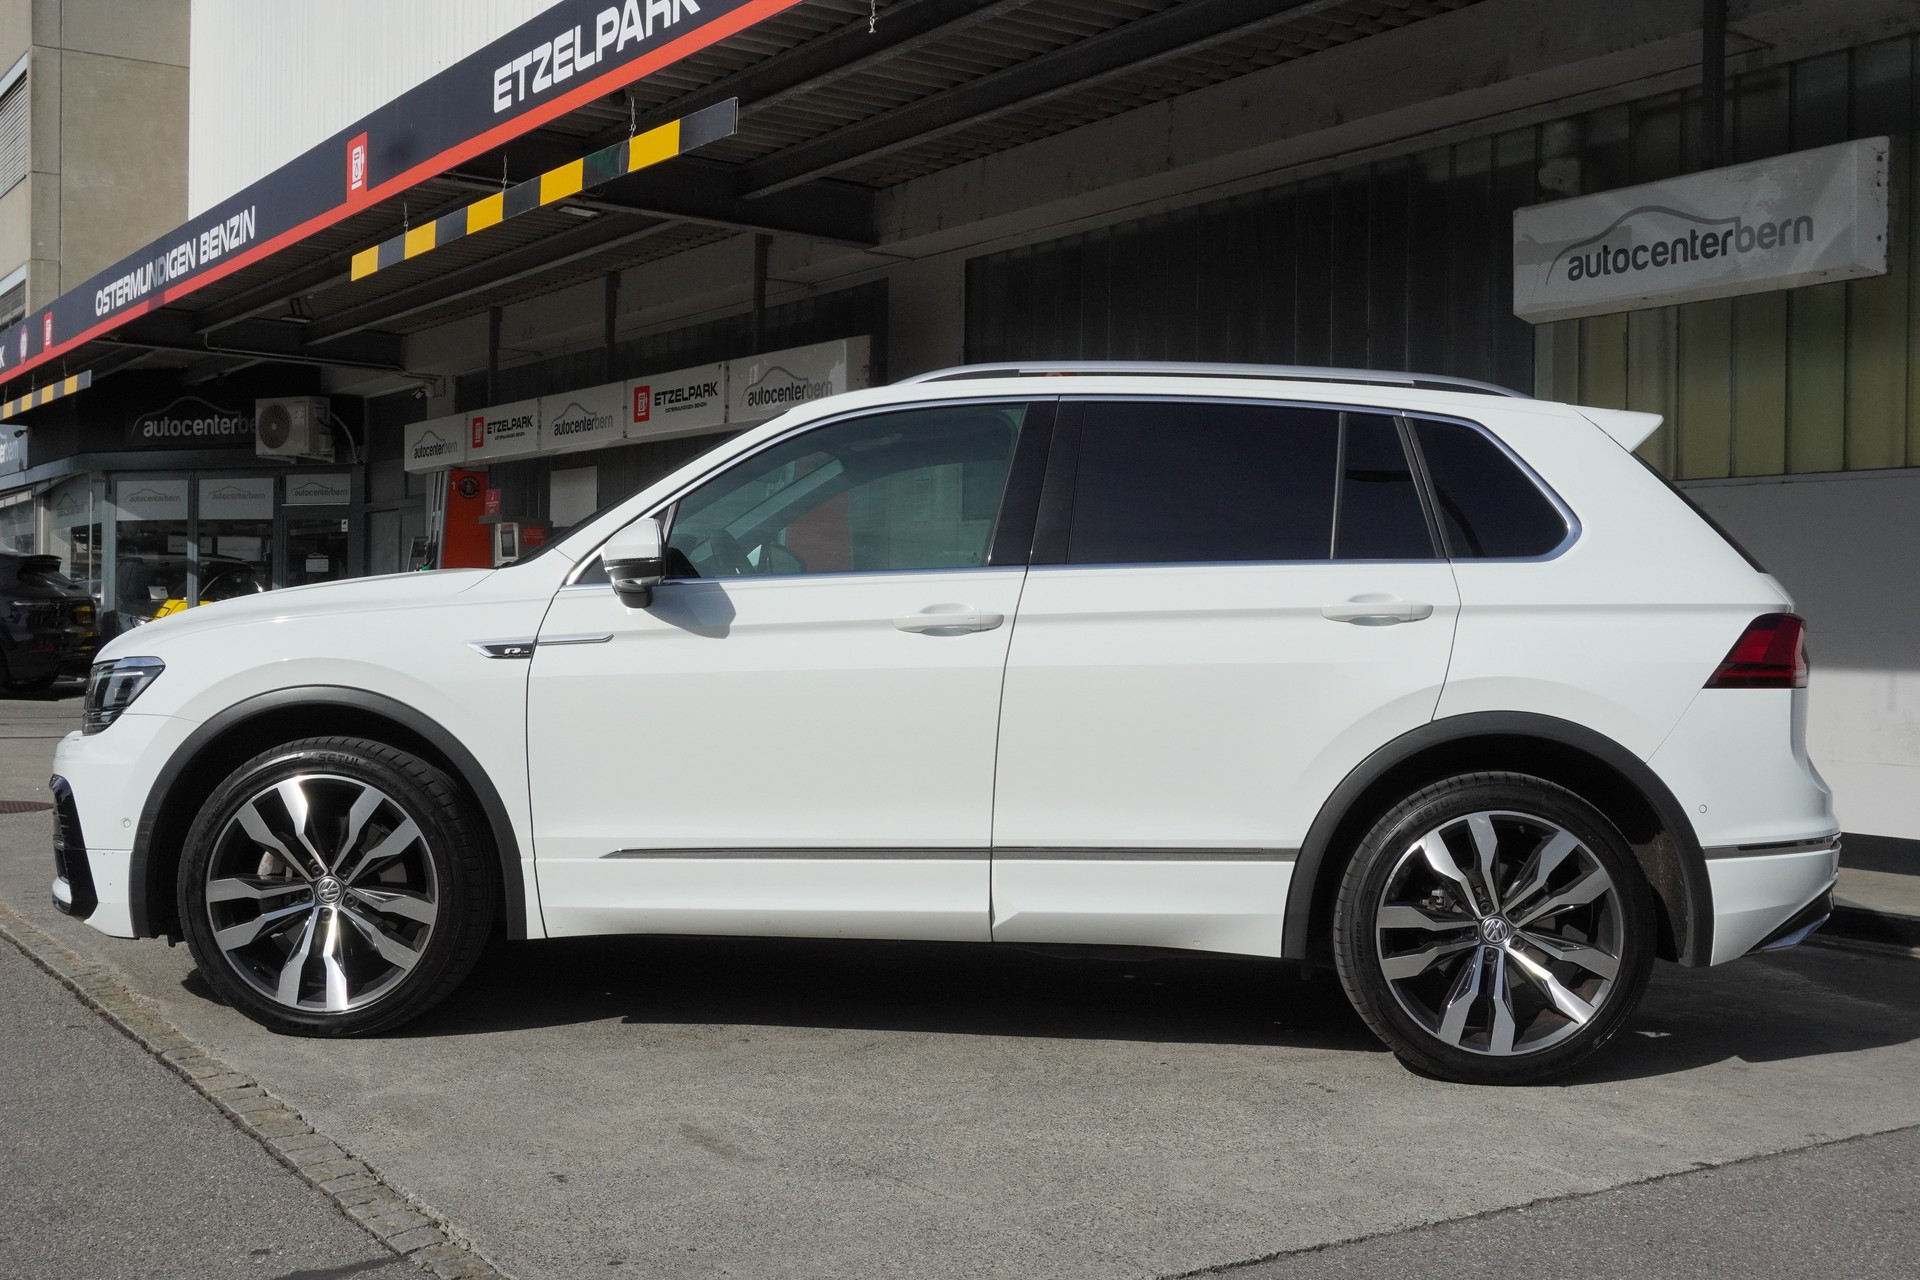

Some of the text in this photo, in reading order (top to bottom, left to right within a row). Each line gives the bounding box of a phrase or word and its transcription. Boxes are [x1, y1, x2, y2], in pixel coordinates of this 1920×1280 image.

[95, 205, 256, 316] OSTERMUNDIGEN BENZIN
[1567, 214, 1814, 282] autocenterbern
[654, 381, 719, 406] ETZELPARK
[487, 415, 534, 434] ETZELPARK
